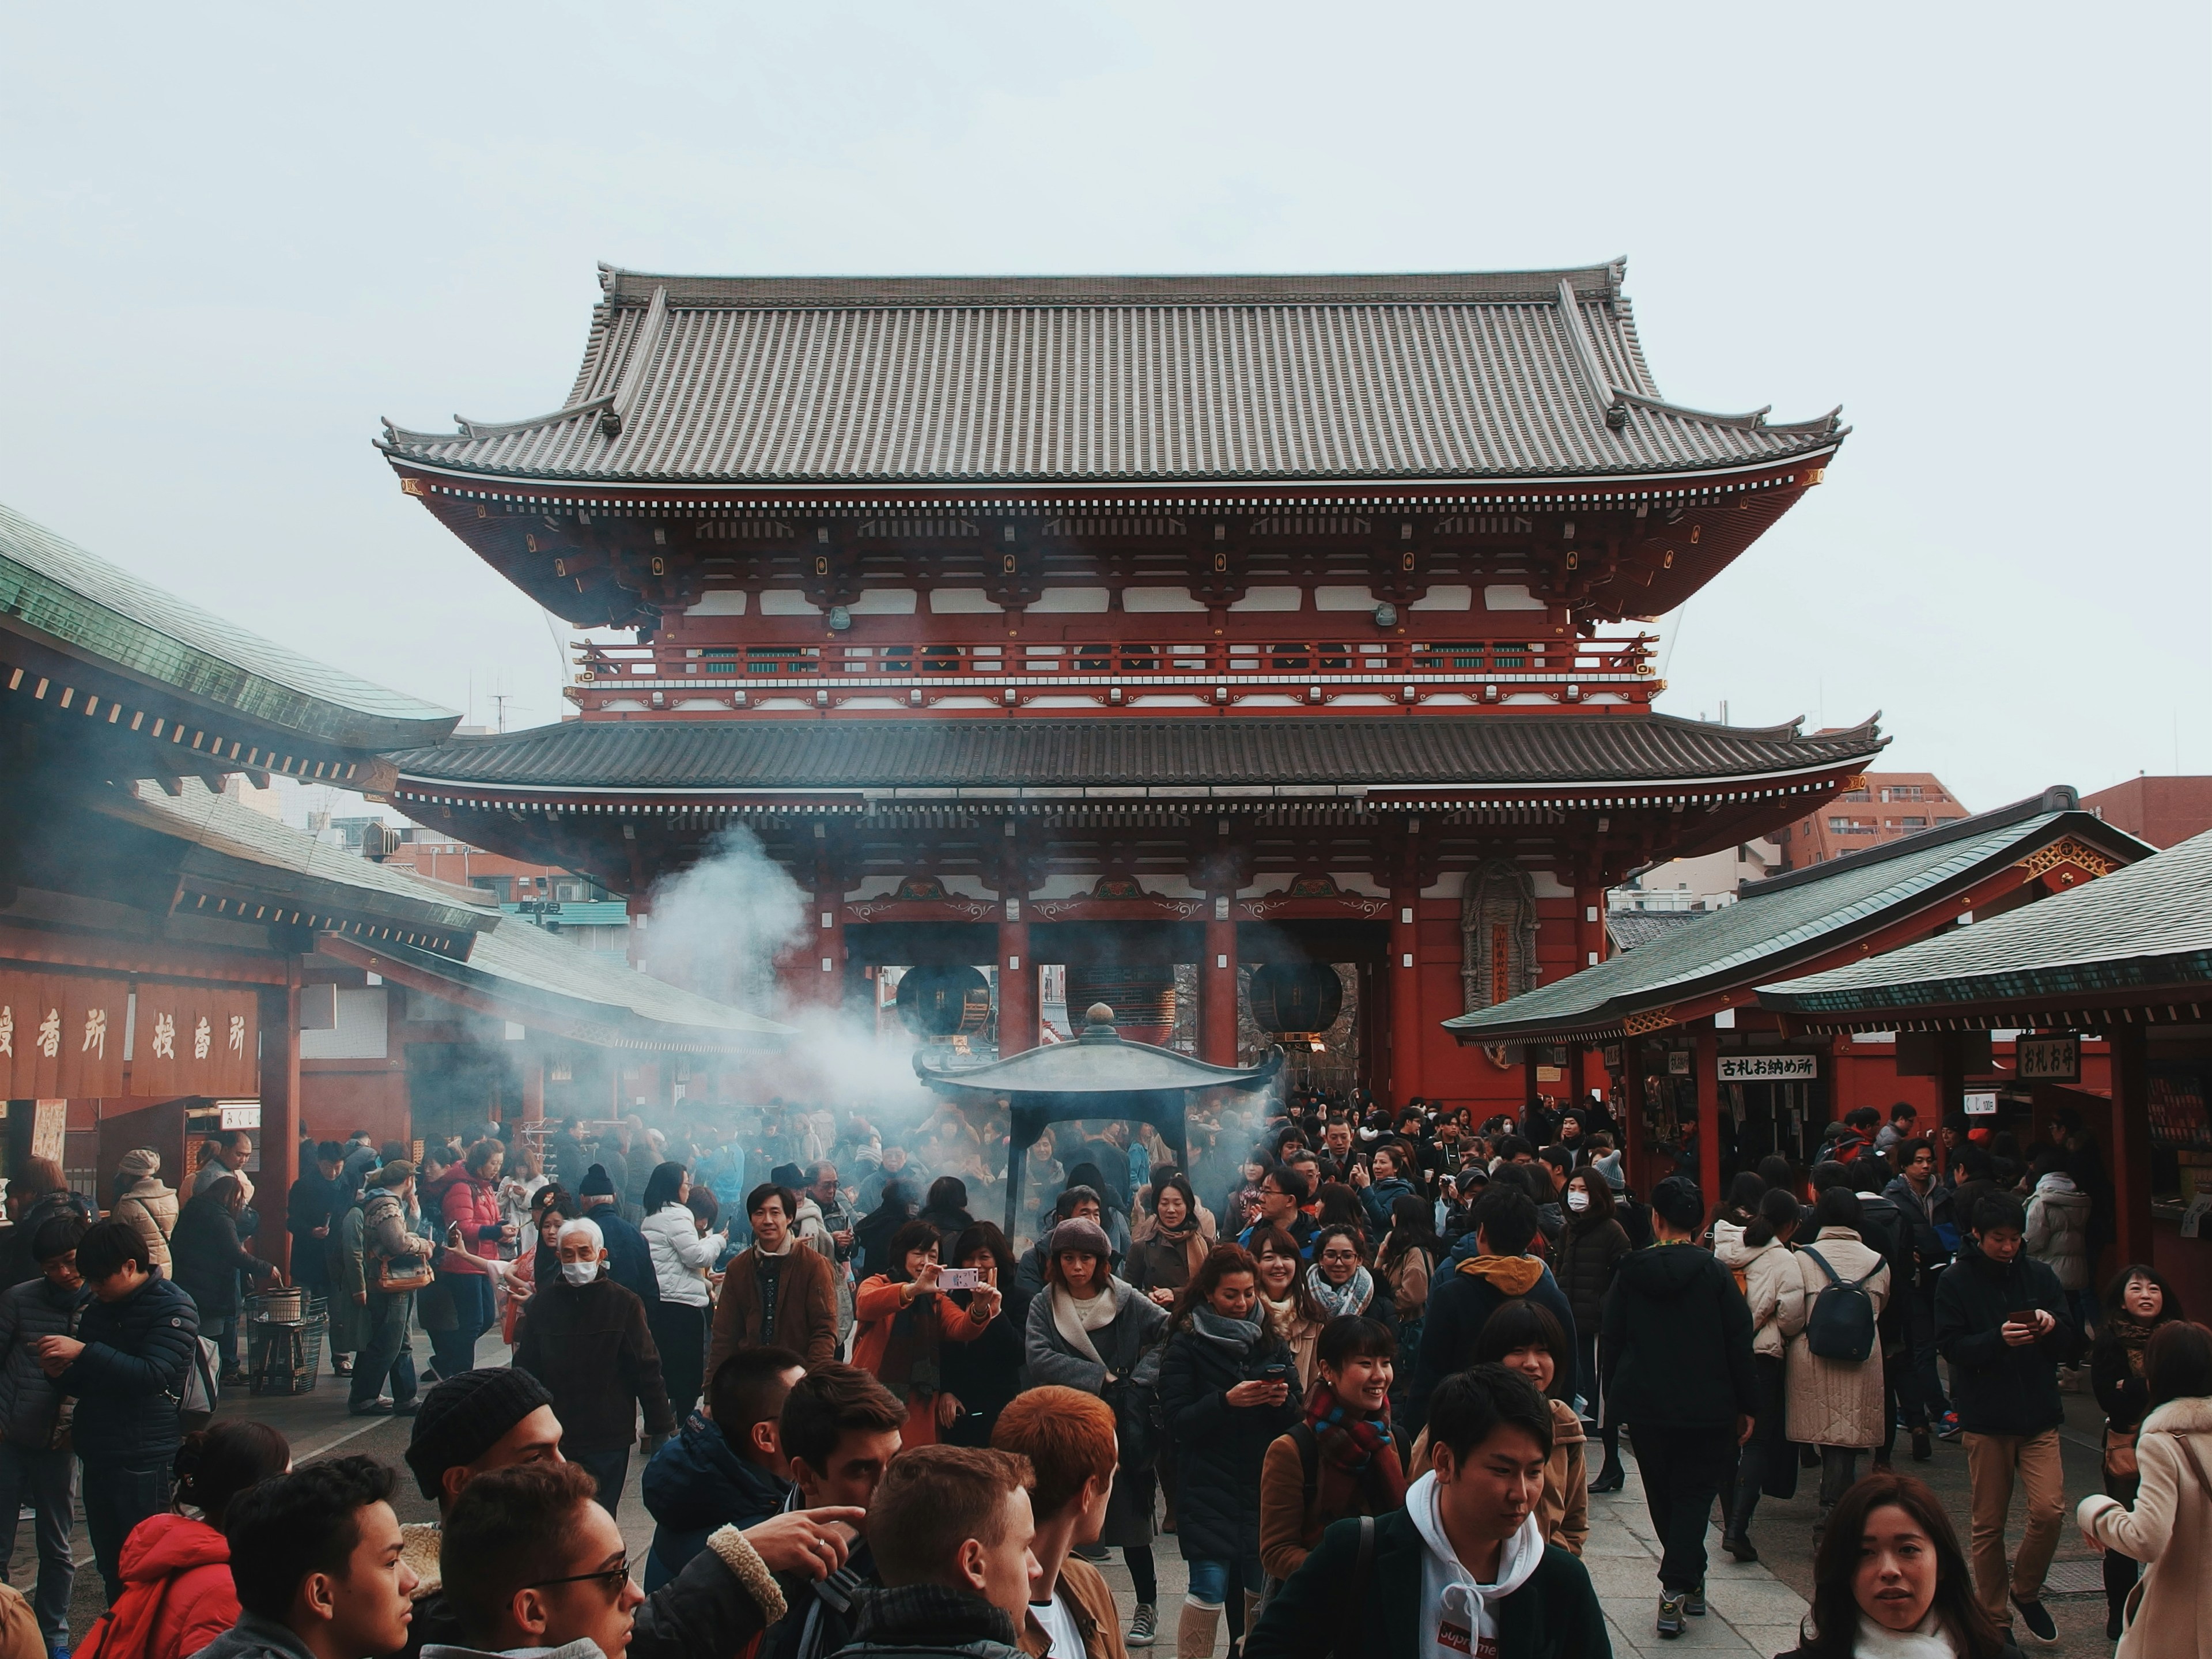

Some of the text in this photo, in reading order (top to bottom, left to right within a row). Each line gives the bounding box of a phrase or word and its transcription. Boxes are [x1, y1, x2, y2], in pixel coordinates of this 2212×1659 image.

[152, 1012, 244, 1060] 授香所
[1722, 1059, 1813, 1076] 古札お納め所
[2025, 1043, 2074, 1074] お札お守
